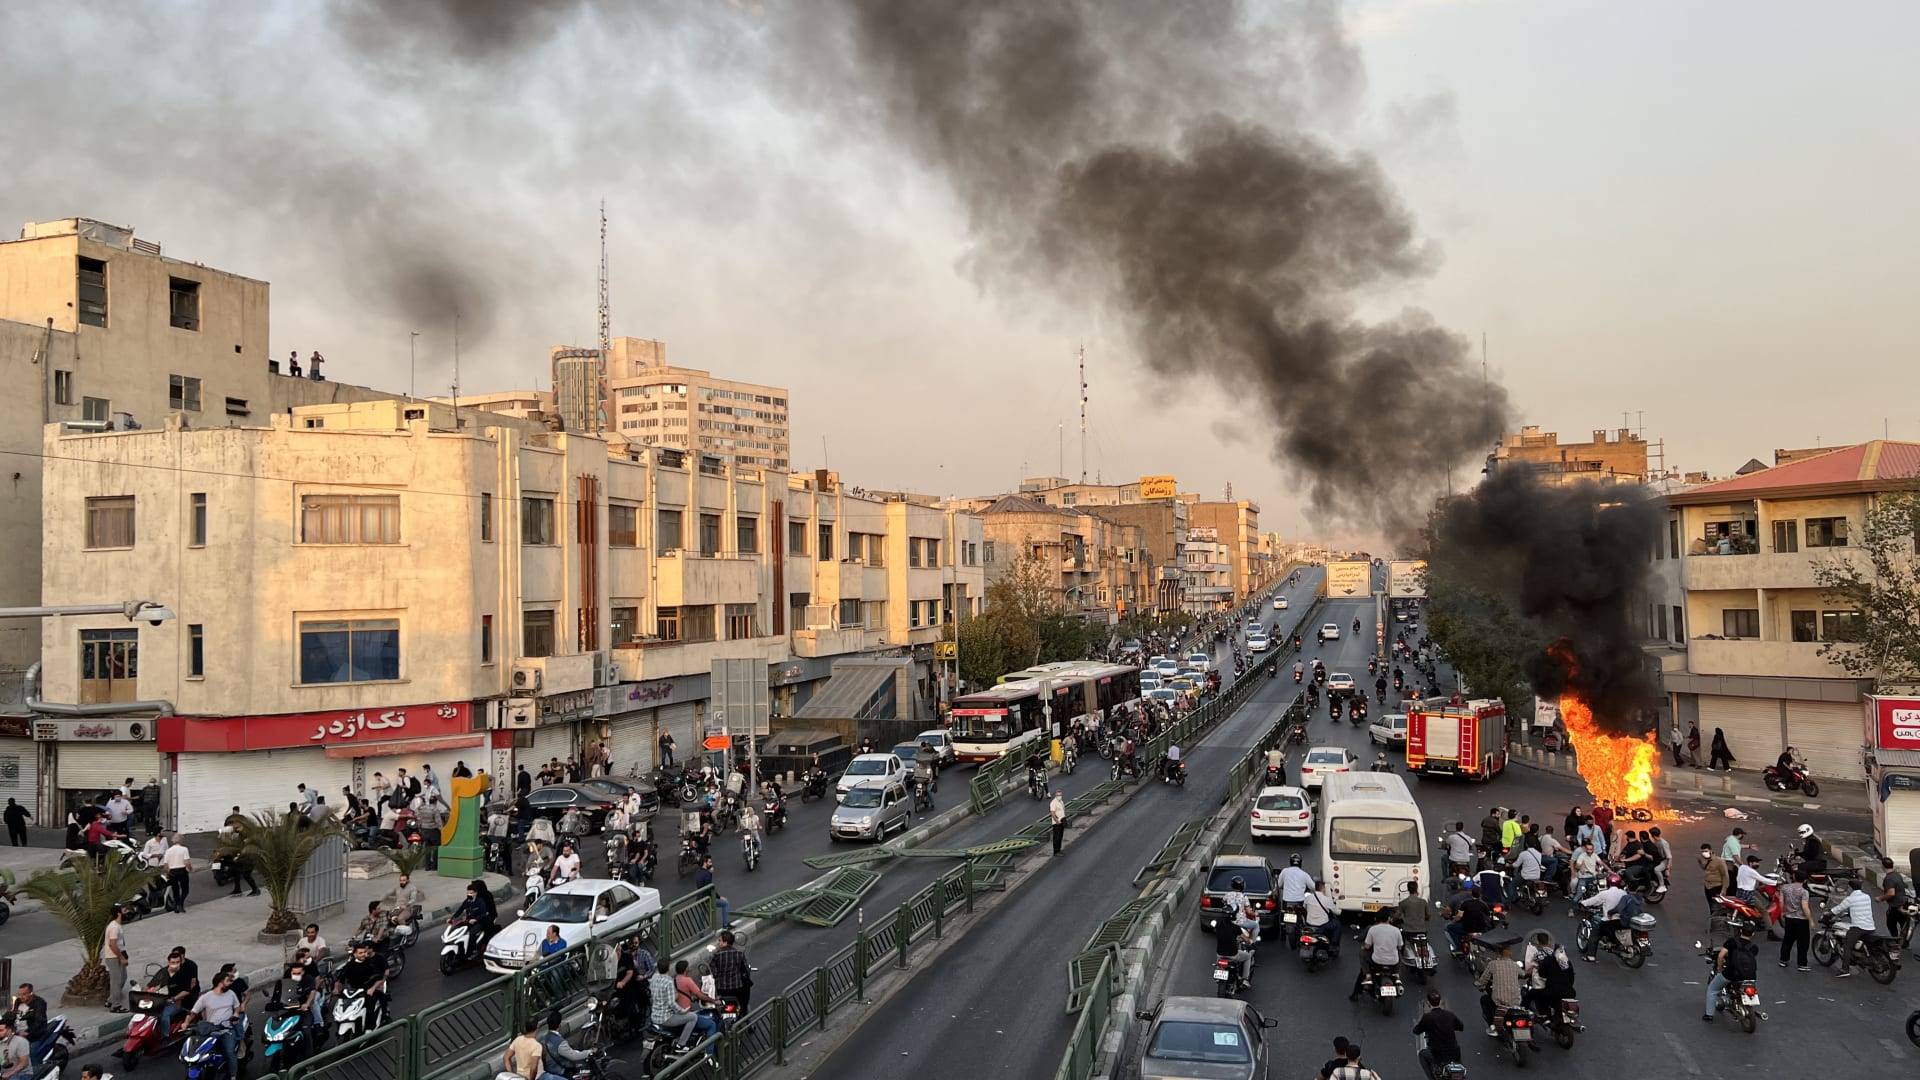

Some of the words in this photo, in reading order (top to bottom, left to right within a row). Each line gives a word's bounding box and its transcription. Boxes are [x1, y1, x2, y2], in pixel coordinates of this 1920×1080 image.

[1143, 487, 1172, 496] رزمندگان
[437, 705, 457, 719] ویژه
[366, 711, 405, 730] تک
